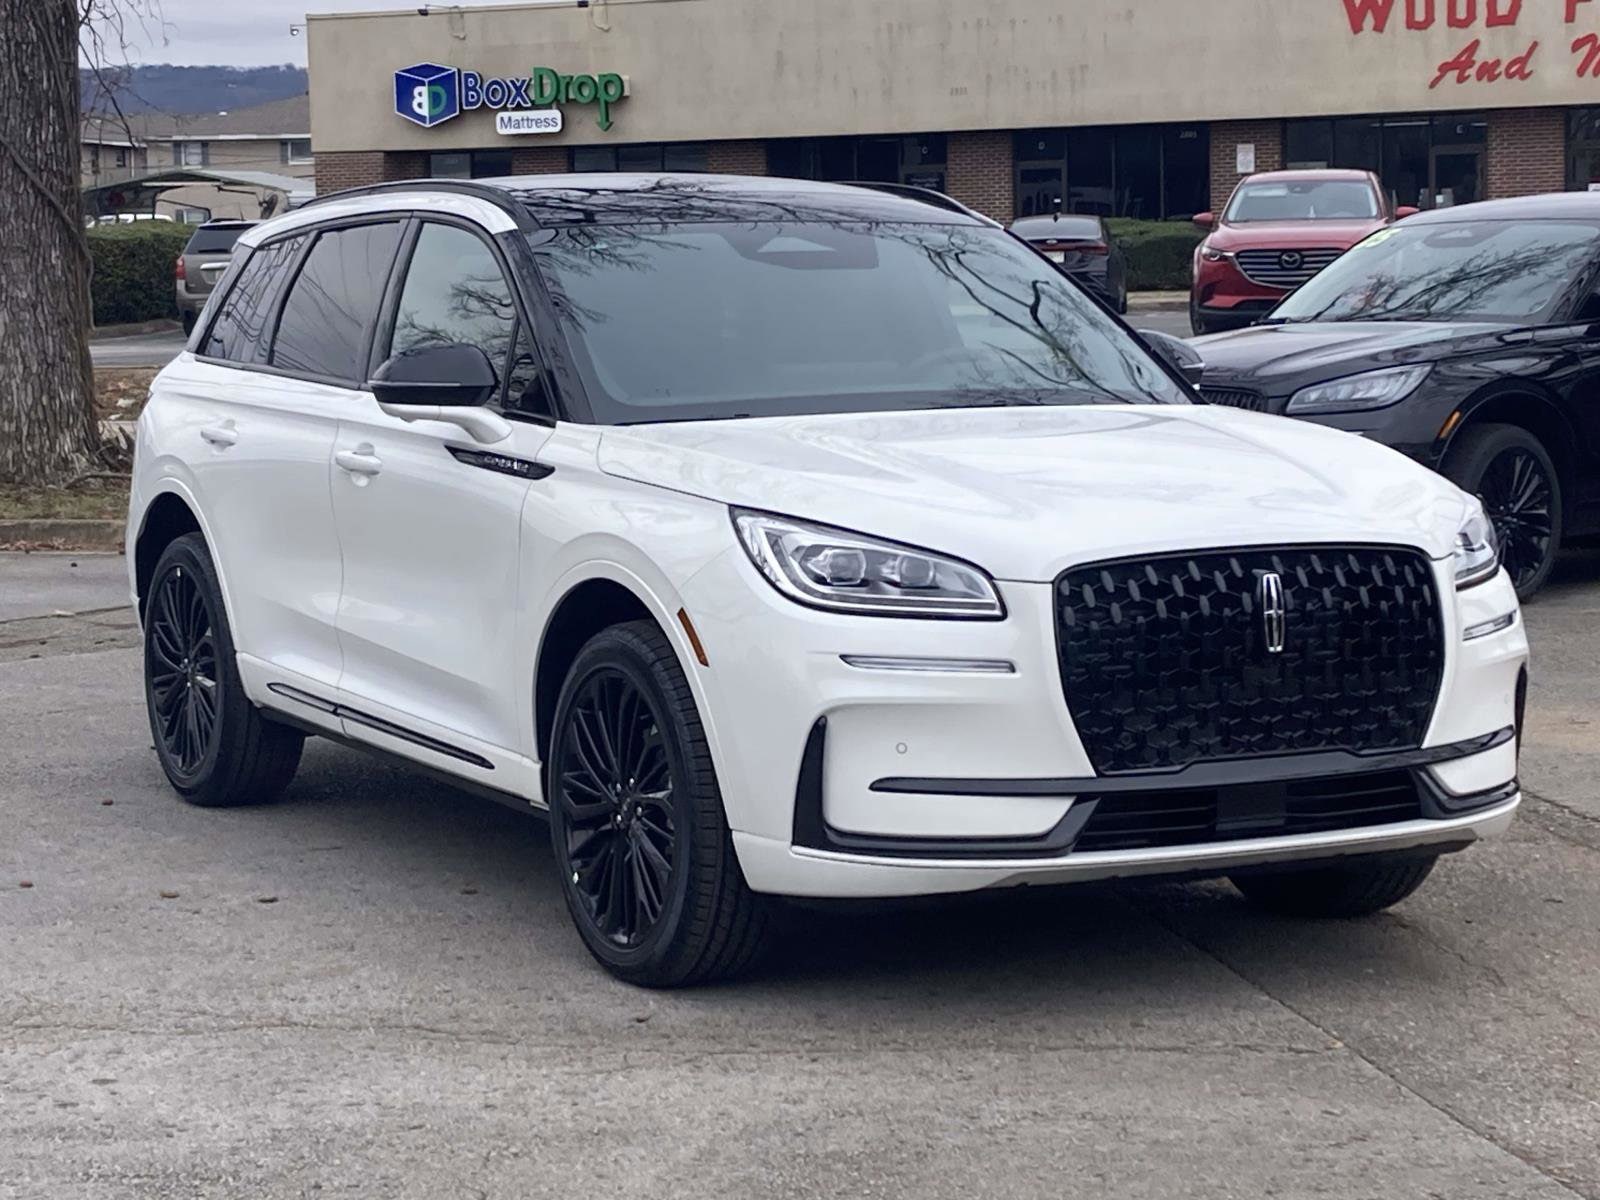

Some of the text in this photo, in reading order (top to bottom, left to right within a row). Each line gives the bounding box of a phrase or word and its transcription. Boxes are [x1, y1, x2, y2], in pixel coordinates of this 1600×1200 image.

[1428, 38, 1539, 89] And
[461, 66, 625, 131] BoxDrop
[499, 112, 559, 131] Mattress
